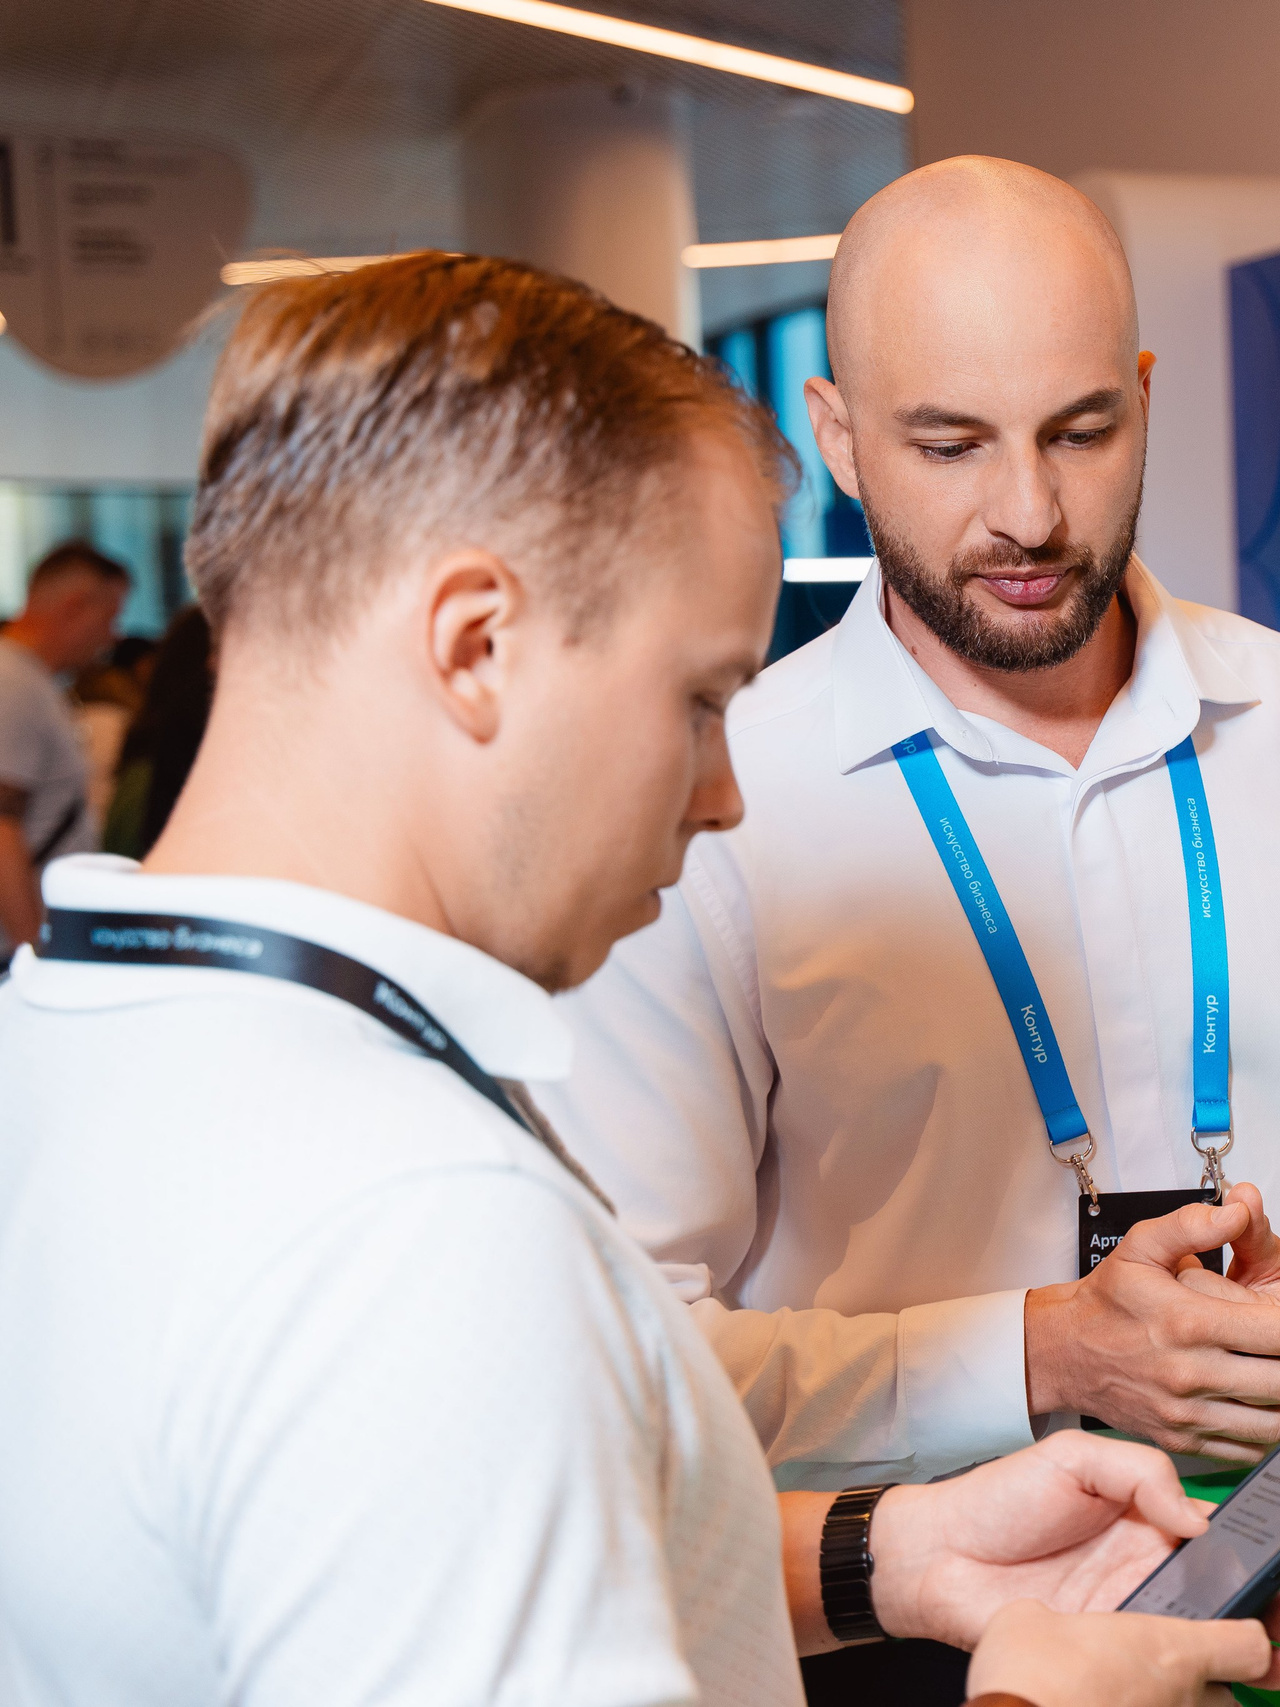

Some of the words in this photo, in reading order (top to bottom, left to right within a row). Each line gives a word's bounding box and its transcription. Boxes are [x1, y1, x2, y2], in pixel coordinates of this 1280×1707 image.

[1187, 797, 1203, 849] бизнеса
[939, 816, 974, 880] искусство
[968, 880, 998, 935] бизнеса
[1196, 851, 1211, 918] искусство
[1020, 1003, 1048, 1063] Контур
[1203, 994, 1219, 1053] Контур
